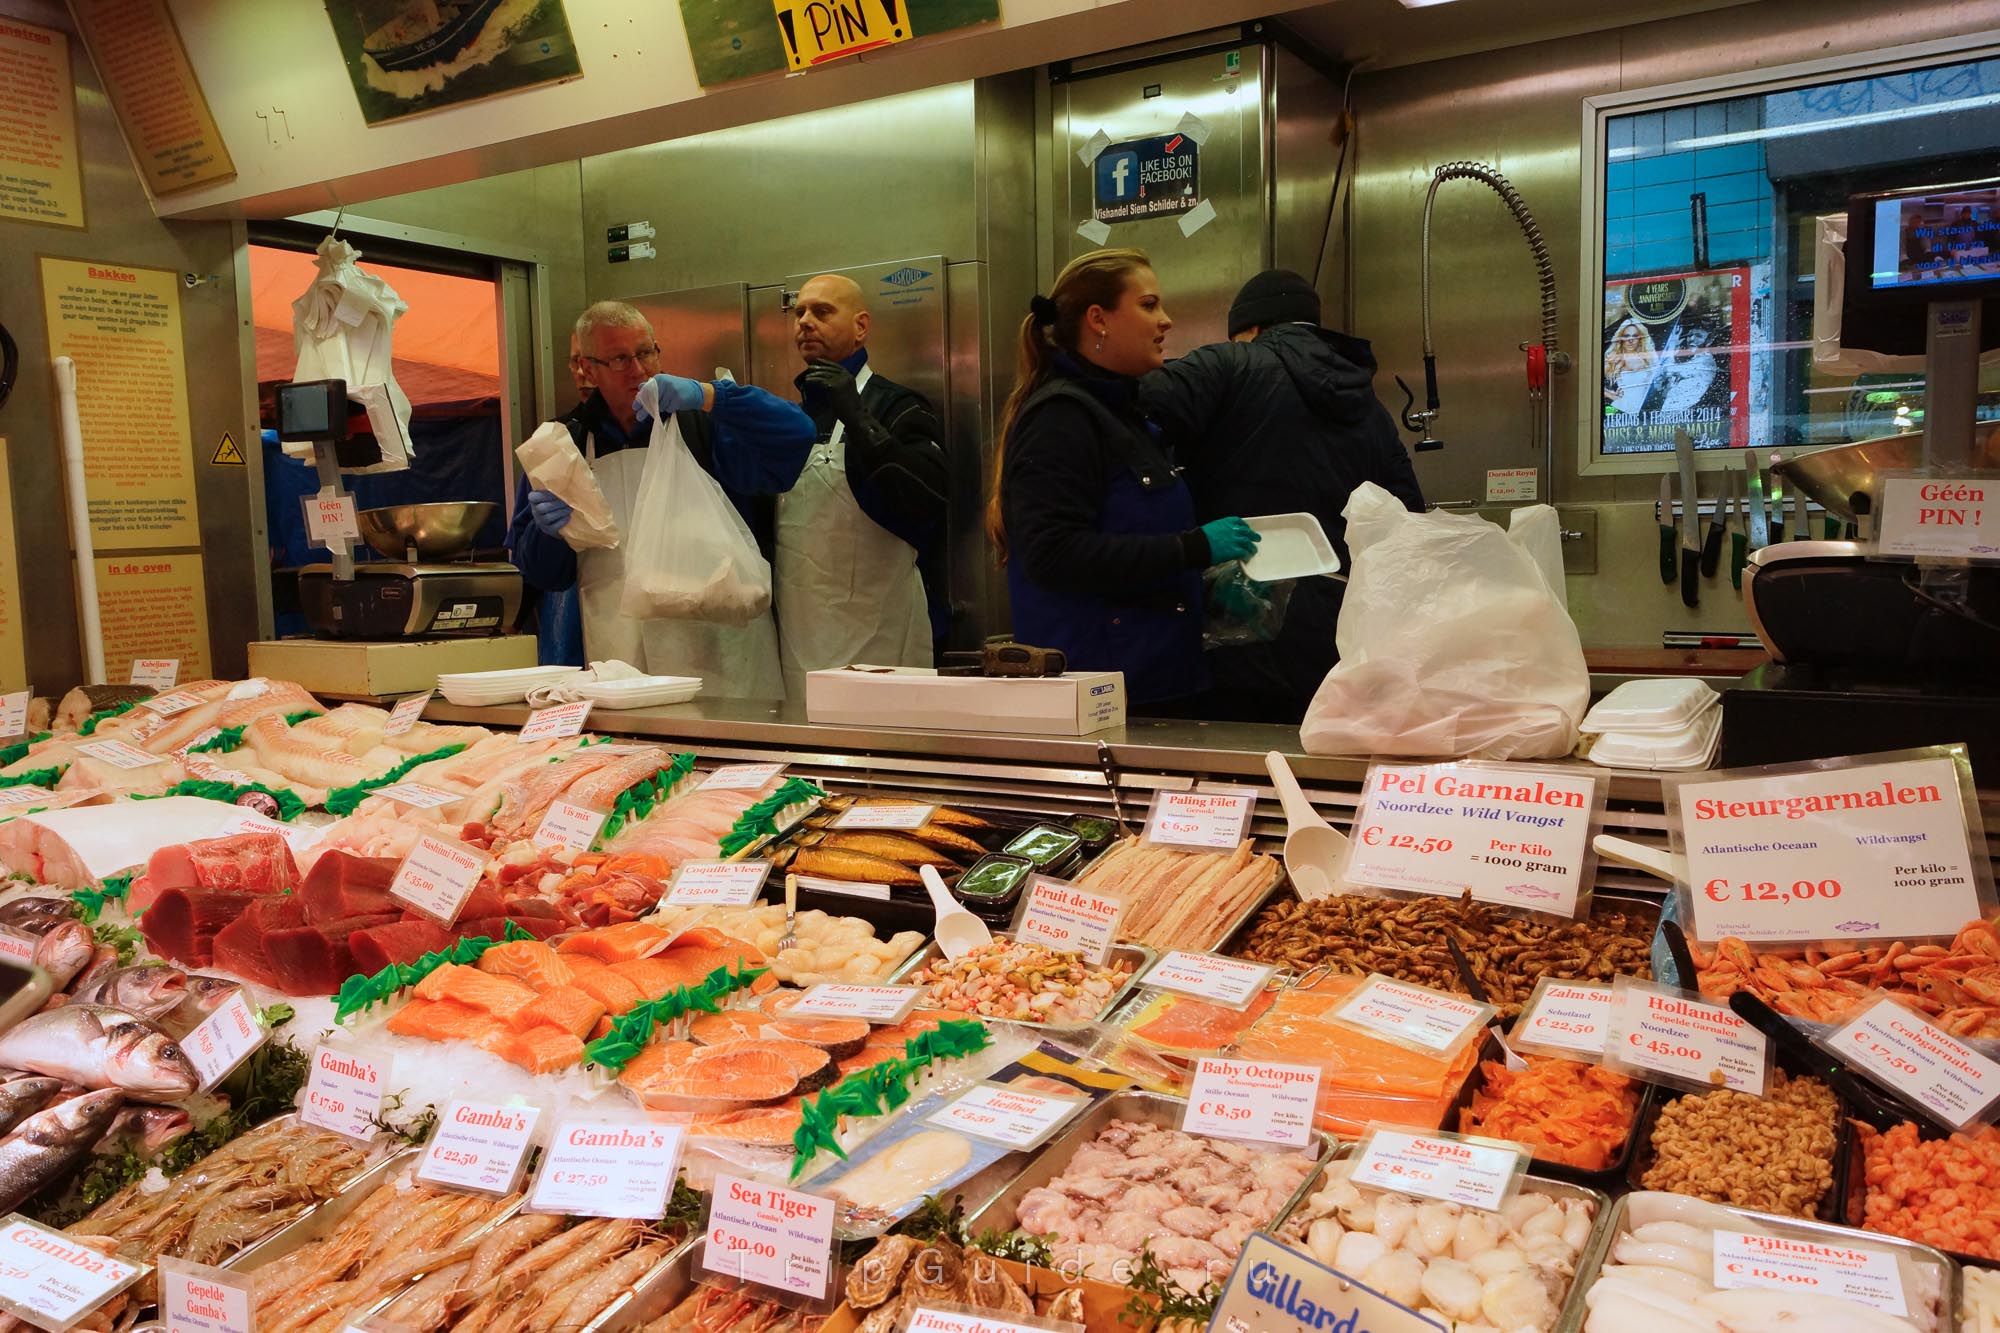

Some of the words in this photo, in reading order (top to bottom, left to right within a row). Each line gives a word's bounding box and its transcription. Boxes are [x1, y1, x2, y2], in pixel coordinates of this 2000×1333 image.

[1140, 159, 1160, 173] LIKE
[1163, 157, 1176, 169] US
[1178, 155, 1192, 167] ON
[1140, 167, 1192, 184] FACEBOOK!
[1095, 205, 1129, 220] Vishandel
[1130, 202, 1148, 215] Siem
[1149, 199, 1179, 212] Schilder
[1181, 197, 1186, 208] &
[88, 267, 136, 282] Bakken
[1732, 275, 1742, 287] R
[1652, 282, 1669, 293] YEARS
[1696, 407, 1721, 422] 2014
[1920, 484, 1985, 502] Géén
[319, 500, 342, 511] Géén
[321, 513, 337, 524] PIN
[1918, 508, 1968, 526] PIN
[1974, 510, 1982, 526] !
[108, 564, 120, 574] In
[124, 563, 139, 574] de
[143, 562, 172, 573] oven
[1169, 795, 1207, 808] Paling
[1209, 798, 1238, 808] Filet
[1379, 772, 1427, 794] Pel
[1434, 775, 1585, 810] Garnalen
[1695, 781, 1942, 821] Steurgarnalen
[563, 806, 574, 816] Vis
[1376, 800, 1454, 817] Noordzee
[1461, 806, 1501, 821] Wild
[1505, 810, 1566, 829] Vangst
[239, 819, 293, 838] Zwaardvis
[1362, 826, 1384, 847] €
[1387, 833, 1453, 855] 12,50
[1489, 839, 1517, 853] Per
[1520, 843, 1553, 858] Kilo
[1702, 843, 1770, 855] Atlantische
[1772, 840, 1818, 852] Oceaan
[1855, 832, 1928, 847] Wildvangst
[422, 839, 451, 858] Sashimi
[450, 851, 476, 870] Tonijn
[733, 865, 763, 873] Vlees
[1484, 855, 1523, 869] 1000
[1525, 860, 1568, 876] gram
[1895, 864, 1918, 876] Per
[1920, 863, 1947, 874] kilo
[1705, 878, 1731, 902] €
[1740, 879, 1843, 905] 12,00
[1893, 877, 1926, 888] 1000
[1929, 874, 1966, 888] gram
[1034, 885, 1069, 904] Fruit
[1070, 894, 1087, 908] de
[1089, 899, 1118, 917] Mer
[1026, 919, 1036, 930] €
[1038, 922, 1069, 940] 12,50
[1179, 953, 1209, 964] Wilde
[1376, 983, 1438, 1005] Gerookte
[1439, 1000, 1478, 1017] Zalm
[1547, 987, 1588, 1000] Zalm
[1547, 1007, 1591, 1020] Schotland
[1648, 996, 1745, 1029] Hollandse
[1535, 1017, 1549, 1028] €
[1550, 1020, 1595, 1035] 22,50
[1640, 1021, 1690, 1040] Noordzee
[1651, 1013, 1691, 1027] Gepelde
[1692, 1020, 1738, 1039] Garnalen
[1629, 1033, 1643, 1047] €
[1647, 1039, 1702, 1061] 45,00
[1890, 1020, 1984, 1080] Crabgarnalen
[1921, 1025, 1971, 1058] Noorse
[1854, 1031, 1871, 1044] €
[1870, 1042, 1918, 1076] 17,50
[1864, 1020, 1906, 1048] Atlantische
[1906, 1045, 1936, 1067] Oceaan
[1943, 1068, 1985, 1096] Wildvangst
[320, 1052, 378, 1084] Gamba's
[1202, 1061, 1243, 1079] Baby
[1246, 1065, 1315, 1084] Octopus
[310, 1091, 319, 1105] €
[319, 1095, 345, 1114] 17,50
[1204, 1088, 1223, 1096] Stille
[455, 1105, 527, 1133] Gamba's
[1200, 1102, 1212, 1115] €
[1214, 1103, 1252, 1121] 8,50
[568, 1128, 665, 1149] Gamba's
[433, 1145, 444, 1160] €
[444, 1150, 478, 1166] 22,50
[1411, 1139, 1472, 1160] Sepia
[568, 1174, 609, 1187] 27,50
[1391, 1164, 1433, 1181] 8,50
[729, 1182, 762, 1207] Sea
[767, 1191, 817, 1220] Tiger
[713, 1211, 751, 1228] Atlantische
[752, 1221, 777, 1234] Oceaan
[788, 1229, 824, 1245] Wildvangst
[757, 1211, 784, 1224] Gamba's
[713, 1228, 726, 1246] €
[727, 1235, 776, 1259] 30,00
[1743, 1235, 1868, 1263] Pijlinktvis
[11, 1226, 126, 1283] Gamba's
[1751, 1268, 1819, 1287] 10,00
[187, 1280, 226, 1303] Gepelde
[1247, 1261, 1371, 1333] Gillard
[186, 1300, 227, 1322] Gamba's
[914, 1313, 963, 1333] Fines
